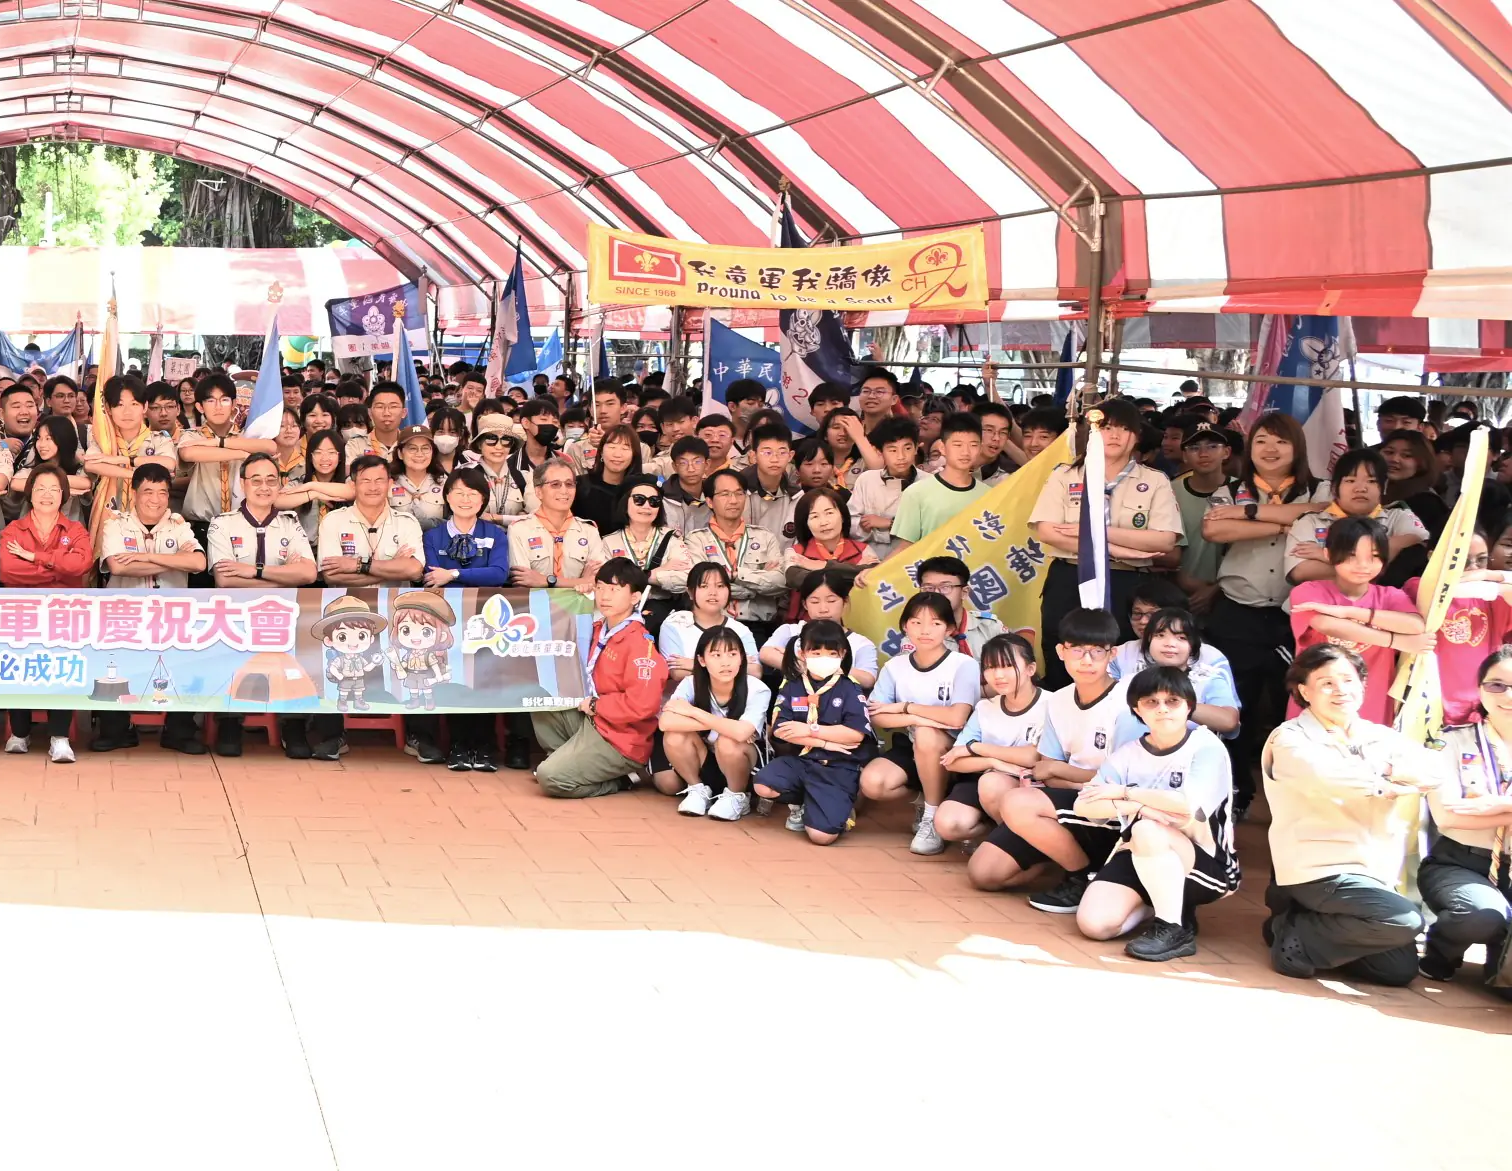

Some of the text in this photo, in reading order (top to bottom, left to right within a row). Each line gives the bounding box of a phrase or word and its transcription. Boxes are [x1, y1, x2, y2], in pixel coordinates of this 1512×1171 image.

[615, 286, 677, 297] SINCE 1968
[712, 358, 780, 383] 中華民
